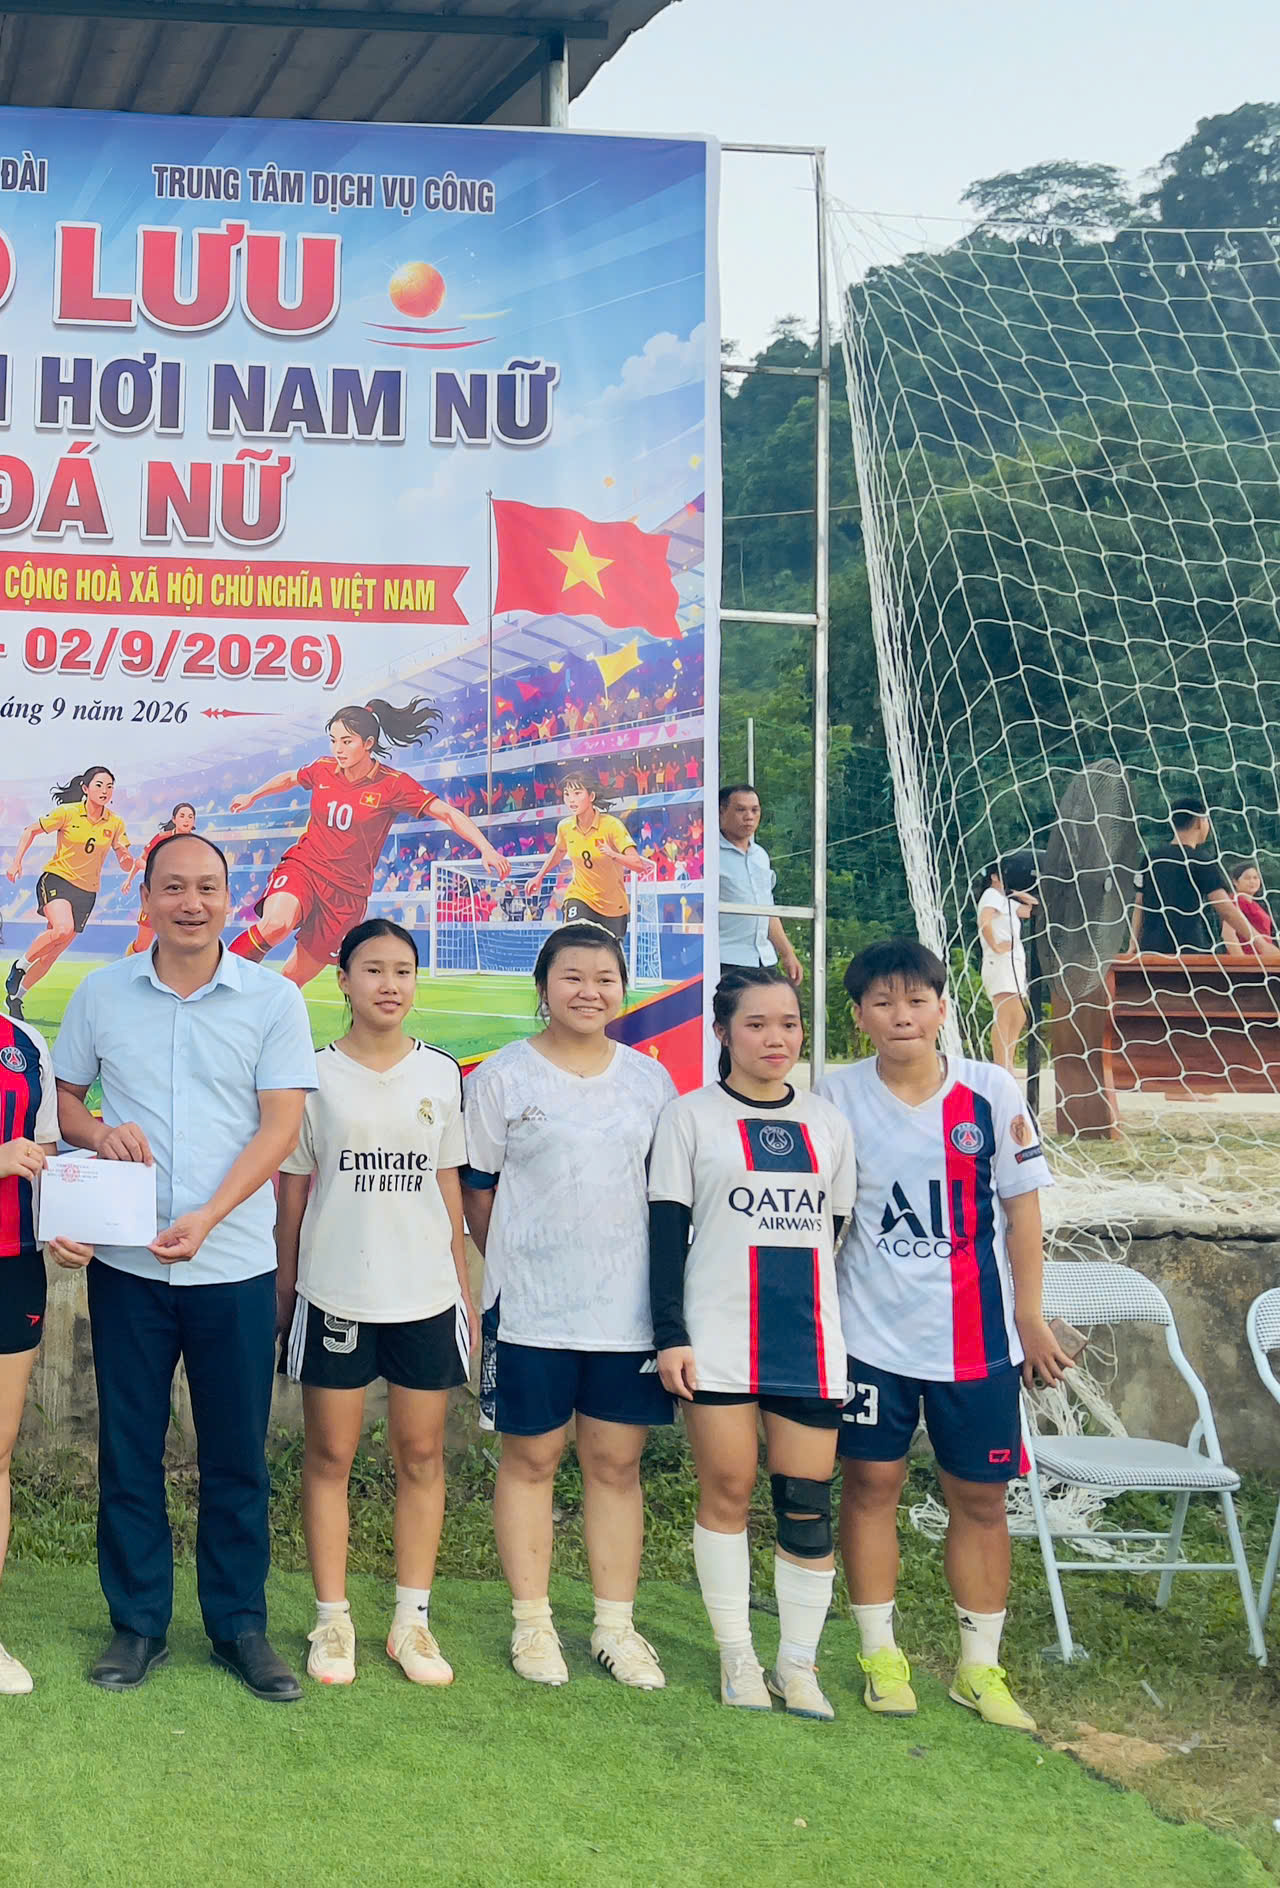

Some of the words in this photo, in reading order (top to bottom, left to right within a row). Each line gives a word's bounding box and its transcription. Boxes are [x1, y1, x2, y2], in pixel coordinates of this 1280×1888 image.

[1, 151, 48, 192] ĐÀI
[153, 164, 240, 202] TRUNG
[248, 163, 304, 204] TÂM
[312, 170, 373, 212] DỊCH
[381, 175, 416, 216] VỤ
[424, 171, 496, 214] CÔNG
[56, 221, 341, 334] LƯU
[37, 352, 184, 433] HƠI
[209, 361, 406, 442] NAM
[431, 359, 559, 444] NỮ
[141, 447, 294, 546] NỮ
[5, 561, 67, 606] CỘNG
[76, 563, 122, 603] HOÀ
[128, 565, 159, 604] XÃ
[167, 566, 203, 612] HỘI
[210, 565, 254, 607] CHỦ
[257, 569, 323, 608] NGHĨA
[330, 572, 376, 617] VIỆT
[383, 578, 436, 612] NAM
[23, 625, 344, 689] 02/9/2026)
[51, 697, 66, 720] 9
[72, 700, 124, 721] năm
[131, 700, 190, 724] 2026
[327, 800, 353, 831] 10
[84, 837, 96, 854] 6
[582, 850, 593, 869] 8
[355, 1175, 375, 1192] FLY
[379, 1175, 423, 1192] BETTER
[758, 1216, 822, 1232] AIRWAYS
[876, 1238, 969, 1258] ACCOR
